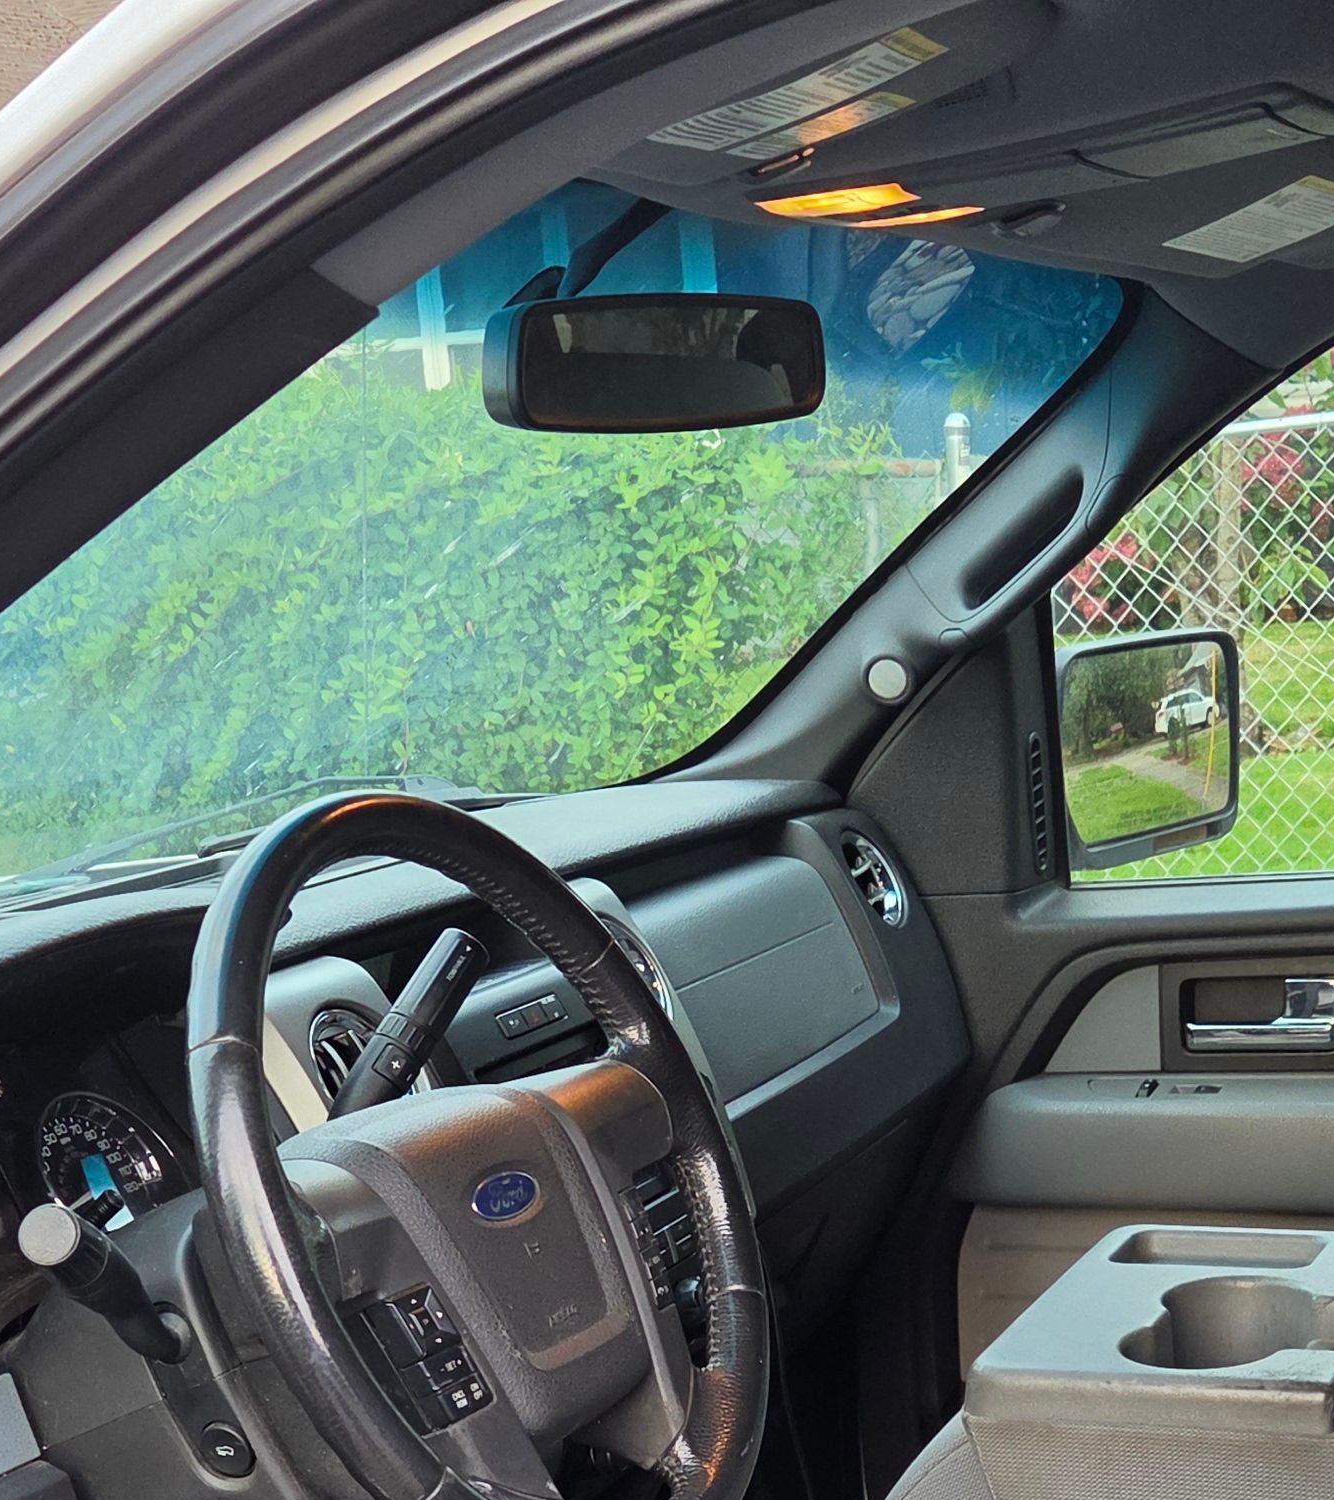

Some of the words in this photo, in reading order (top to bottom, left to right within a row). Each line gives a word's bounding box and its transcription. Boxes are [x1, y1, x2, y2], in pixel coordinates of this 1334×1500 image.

[53, 1123, 68, 1136] 60
[69, 1124, 83, 1136] 70
[84, 1129, 98, 1142] 80
[43, 1133, 57, 1146] 50
[97, 1139, 111, 1152] 90
[106, 1151, 122, 1164] 100
[488, 1179, 528, 1213] Ford
